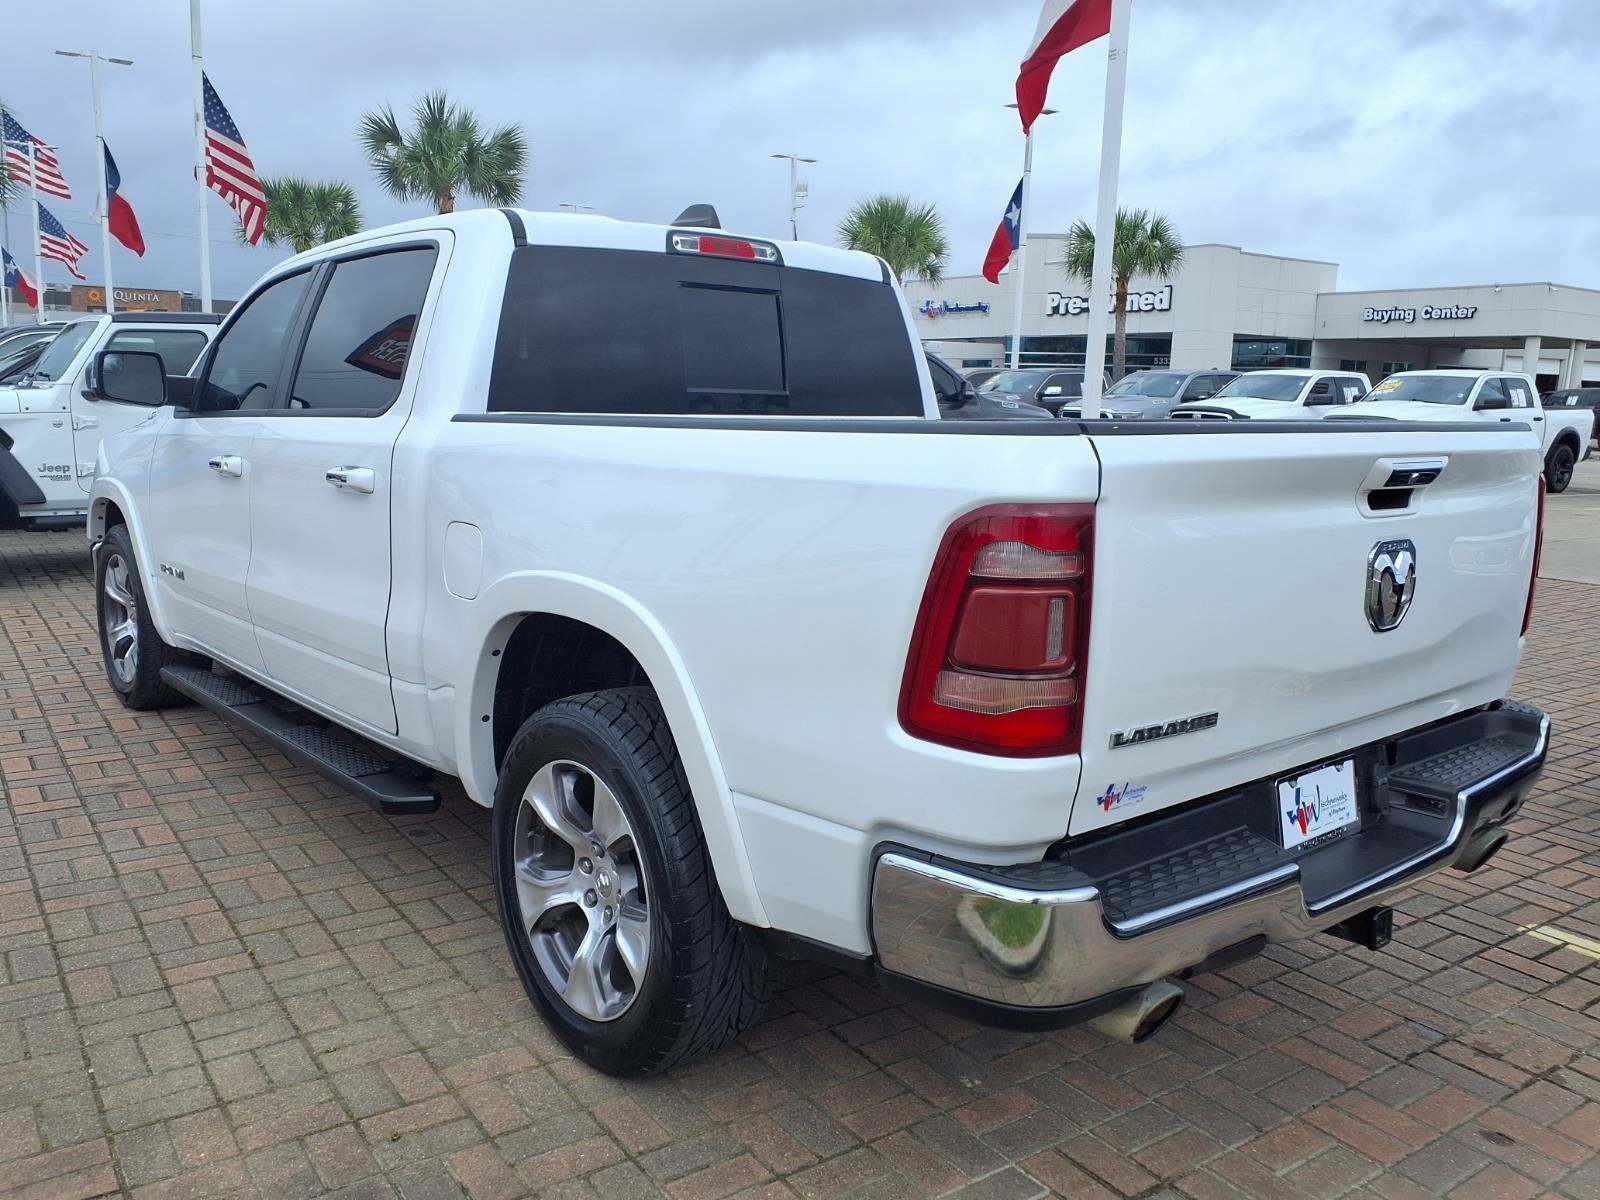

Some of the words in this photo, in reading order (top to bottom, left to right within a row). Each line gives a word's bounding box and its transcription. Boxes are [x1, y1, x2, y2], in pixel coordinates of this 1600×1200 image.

[114, 290, 161, 303] QUINTA
[1046, 285, 1172, 316] Pre-ned
[1364, 306, 1415, 323] Buying
[1421, 305, 1477, 320] Center
[1153, 357, 1171, 365] 533
[38, 463, 71, 473] Jeep
[1109, 712, 1219, 749] LARAMIE
